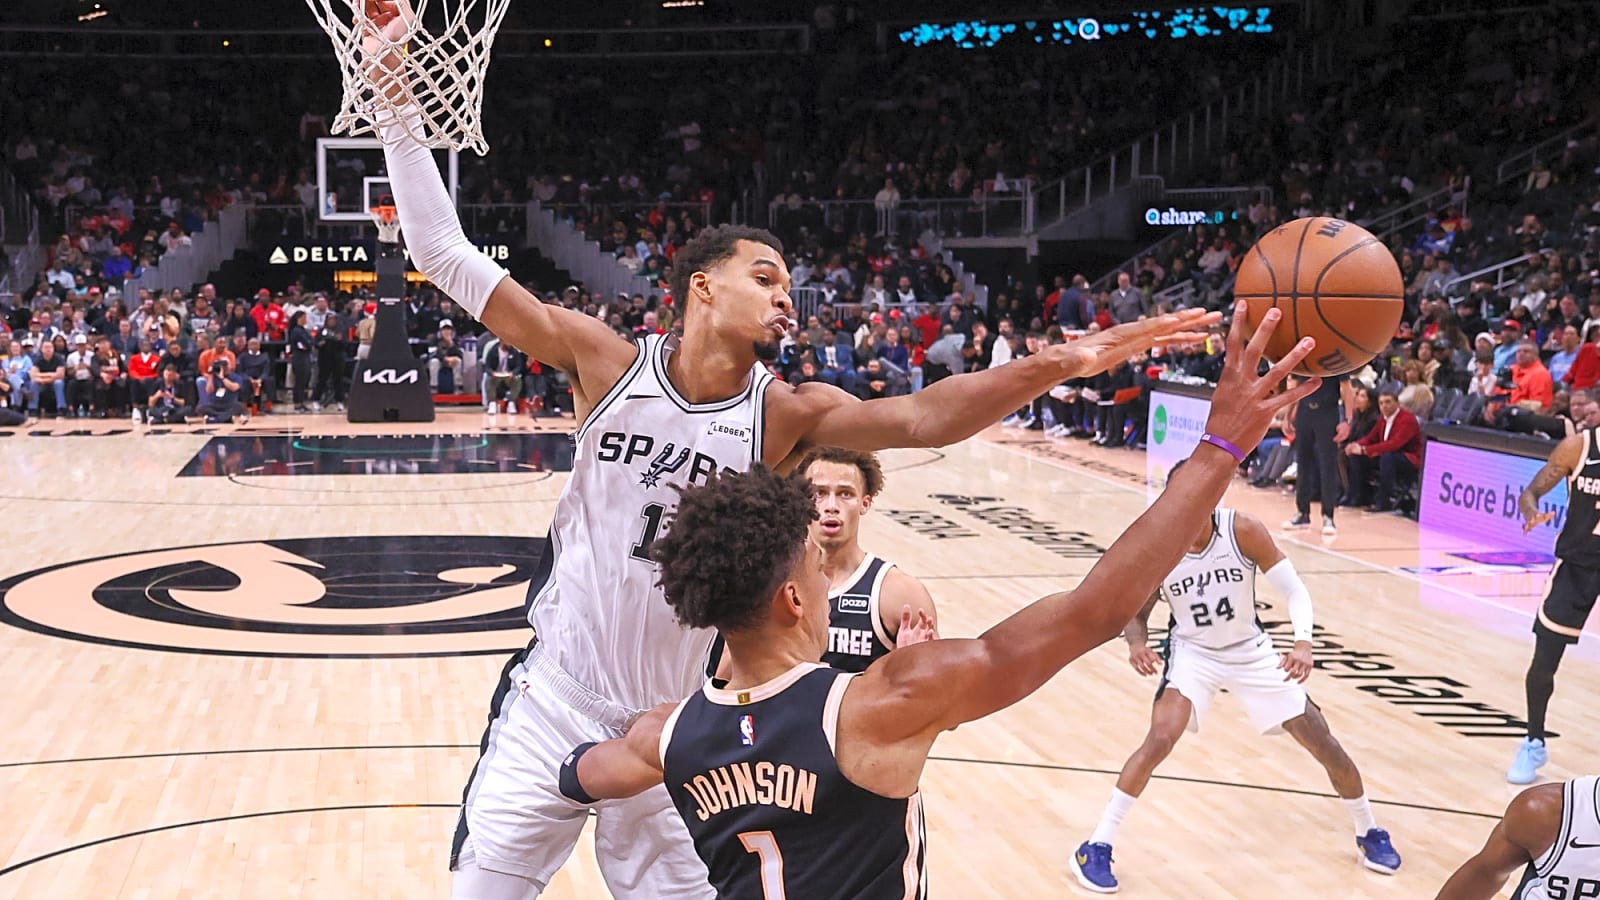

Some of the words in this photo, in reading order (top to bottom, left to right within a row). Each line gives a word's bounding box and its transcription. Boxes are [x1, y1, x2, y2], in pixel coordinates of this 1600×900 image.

[293, 246, 369, 262] DELTA
[712, 425, 746, 438] LEDGER
[597, 431, 739, 491] SPUR
[1439, 472, 1496, 514] Score
[628, 501, 666, 566] 1
[1169, 568, 1244, 598] SPURS
[841, 598, 867, 609] paze
[1190, 597, 1235, 627] 24
[828, 627, 873, 656] TREE
[682, 761, 817, 822] JOHNSON
[737, 830, 786, 900] 1
